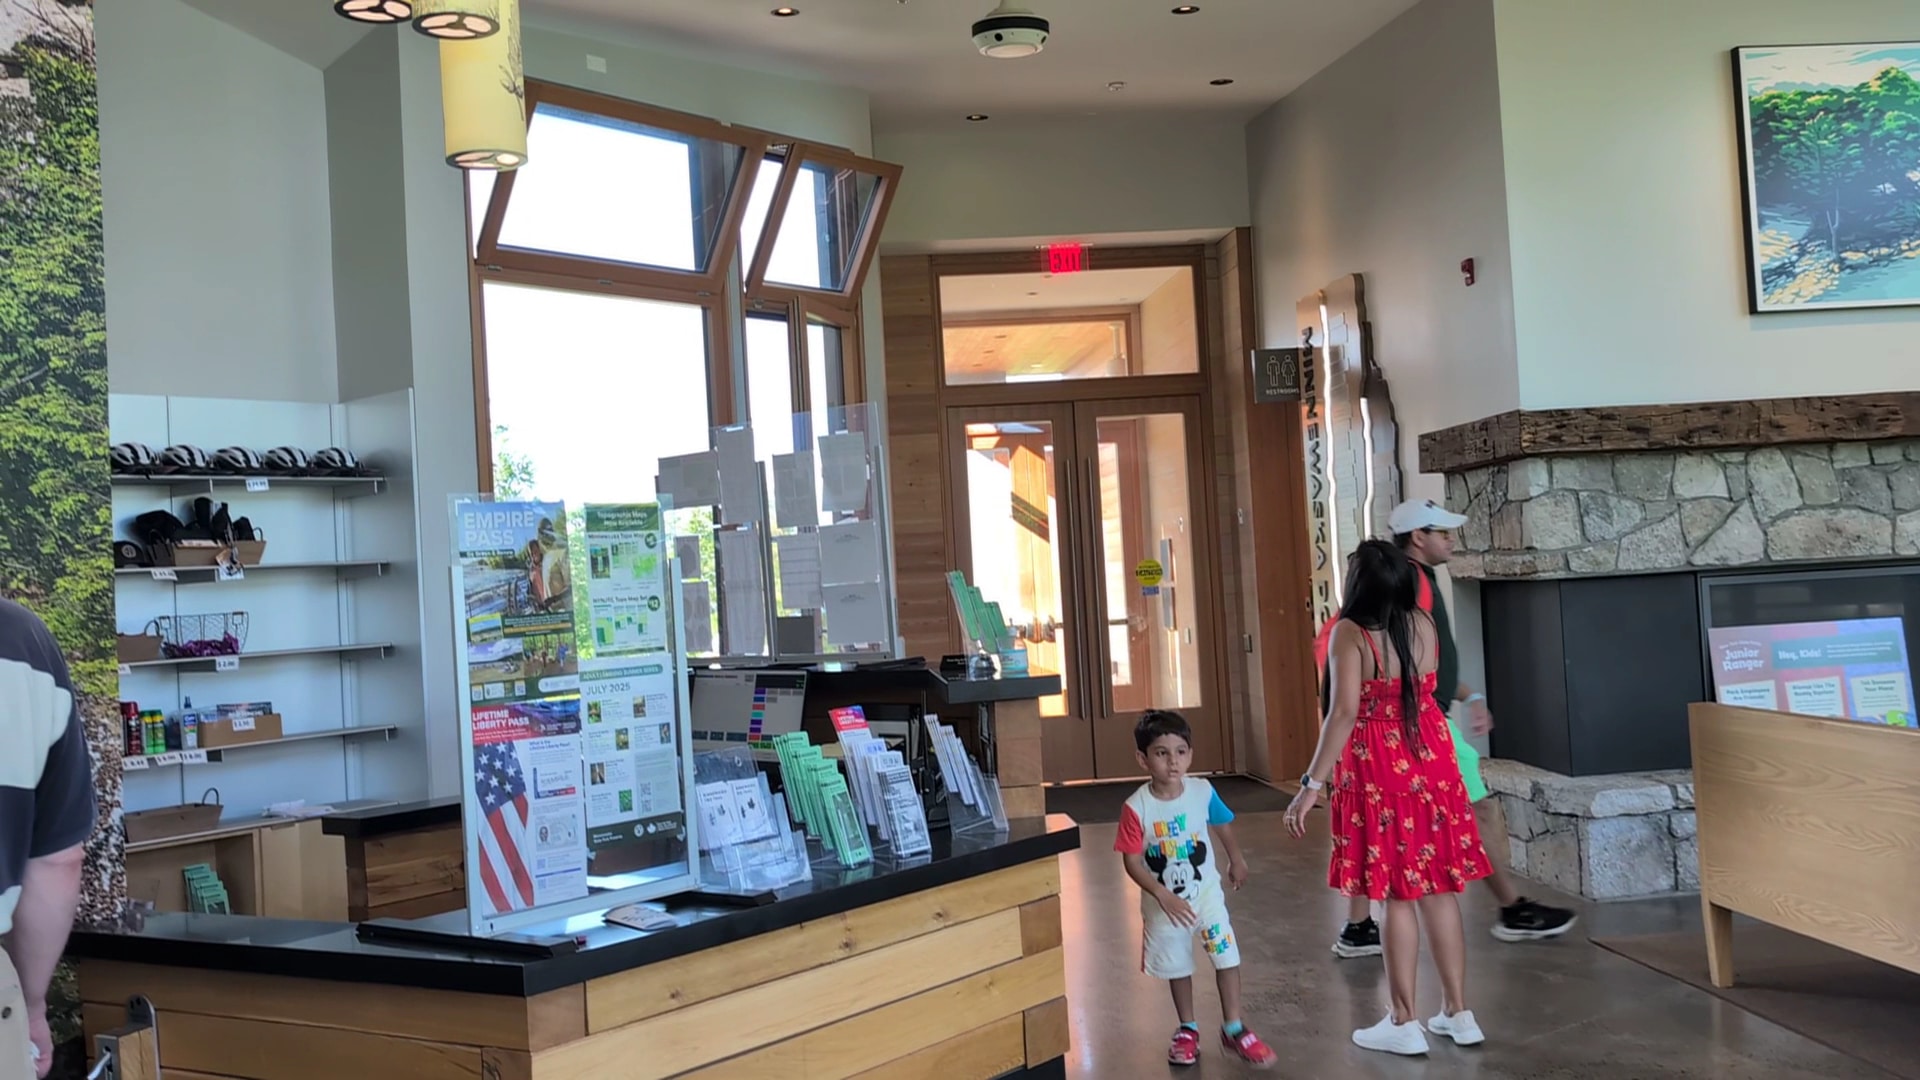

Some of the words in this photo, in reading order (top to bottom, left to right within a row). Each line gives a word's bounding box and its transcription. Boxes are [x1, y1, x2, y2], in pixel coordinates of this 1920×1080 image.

[1050, 247, 1081, 273] EXIT
[1265, 387, 1299, 395] RESTROOMS
[1302, 326, 1327, 571] MINNEWASKA
[463, 511, 534, 528] EMPIRE
[465, 529, 514, 546] PASS
[1725, 647, 1759, 660] Junior
[1778, 650, 1799, 660] Hey,
[1800, 649, 1821, 658] Kids!
[1722, 660, 1764, 671] Ranger
[586, 685, 607, 695] JULY
[609, 682, 631, 693] 2025
[472, 709, 509, 721] LIFETIME
[473, 719, 506, 730] LIBERTY
[508, 717, 530, 726] PASS
[1153, 812, 1187, 838] HEY
